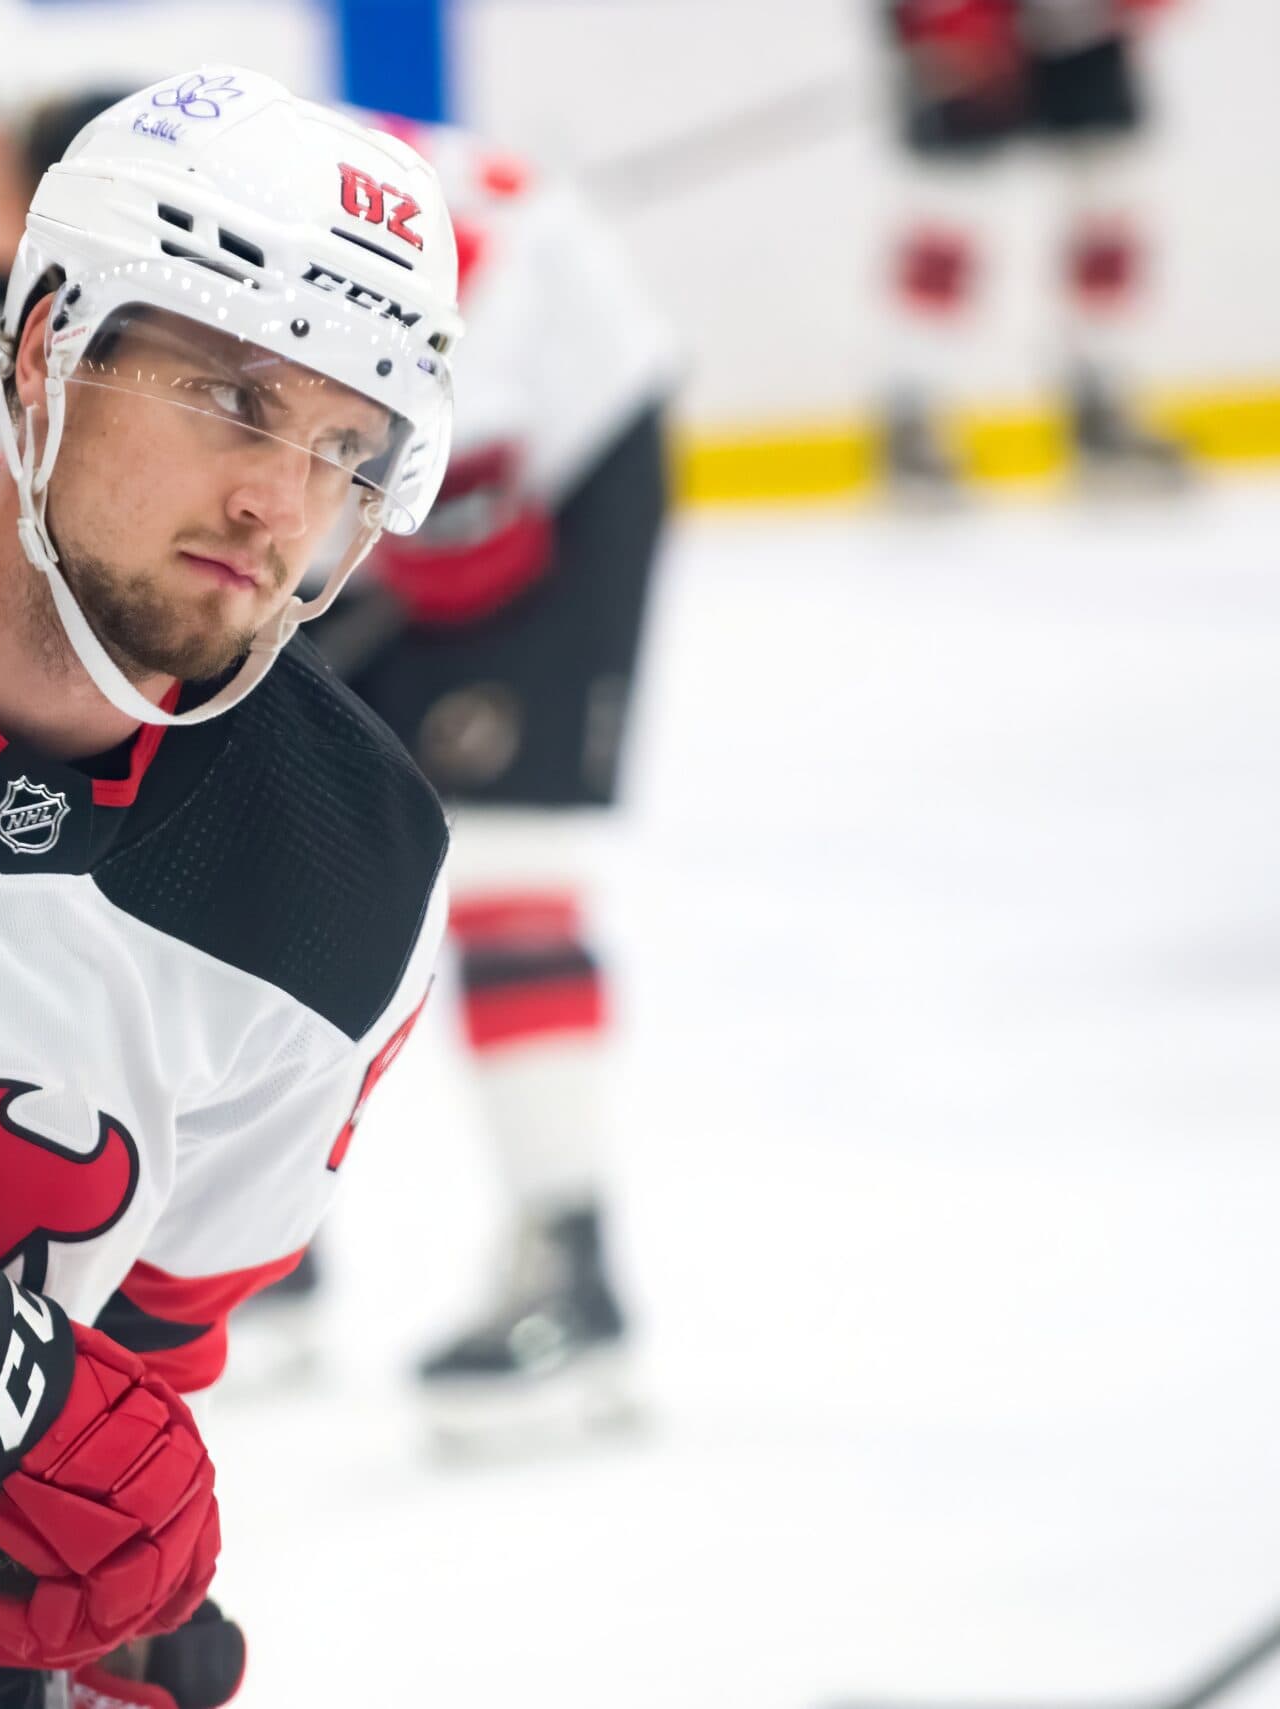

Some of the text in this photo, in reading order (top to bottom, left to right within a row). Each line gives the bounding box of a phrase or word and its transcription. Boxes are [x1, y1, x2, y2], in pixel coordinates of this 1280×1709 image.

[337, 161, 424, 253] 82
[300, 261, 423, 329] CCM
[6, 806, 53, 830] NHL
